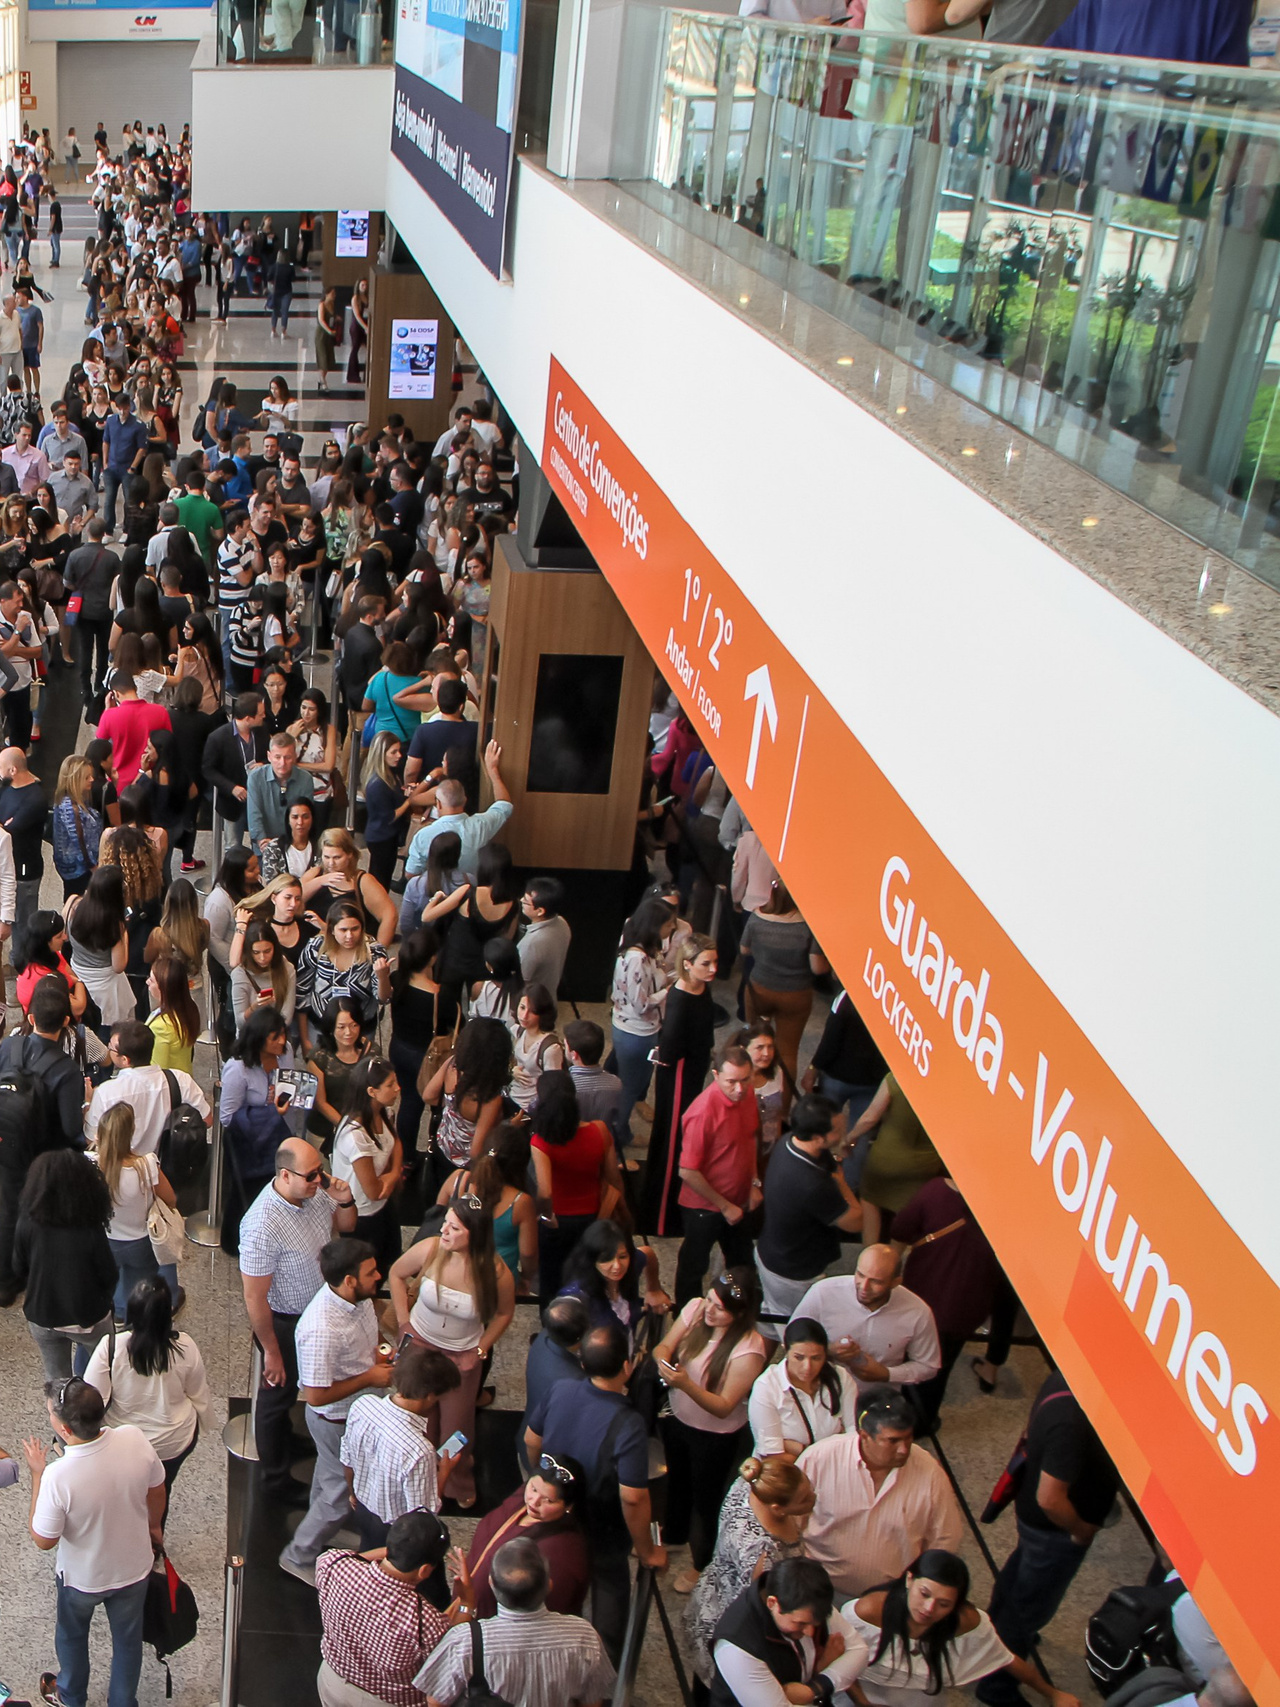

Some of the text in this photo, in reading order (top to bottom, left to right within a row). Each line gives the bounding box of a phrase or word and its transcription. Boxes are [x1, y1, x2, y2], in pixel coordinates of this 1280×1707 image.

[20, 72, 29, 84] H
[436, 130, 459, 180] Welcome!
[461, 152, 497, 217] Bienvenido!
[549, 446, 588, 517] CONVENTION CENTER
[553, 391, 649, 560] Centro de Convenções
[665, 627, 694, 689] Andar
[697, 686, 722, 738] FLOOR
[862, 948, 933, 1077] LOCKERS
[879, 855, 1005, 1096] Guarda
[1031, 1051, 1269, 1476] Volumes
